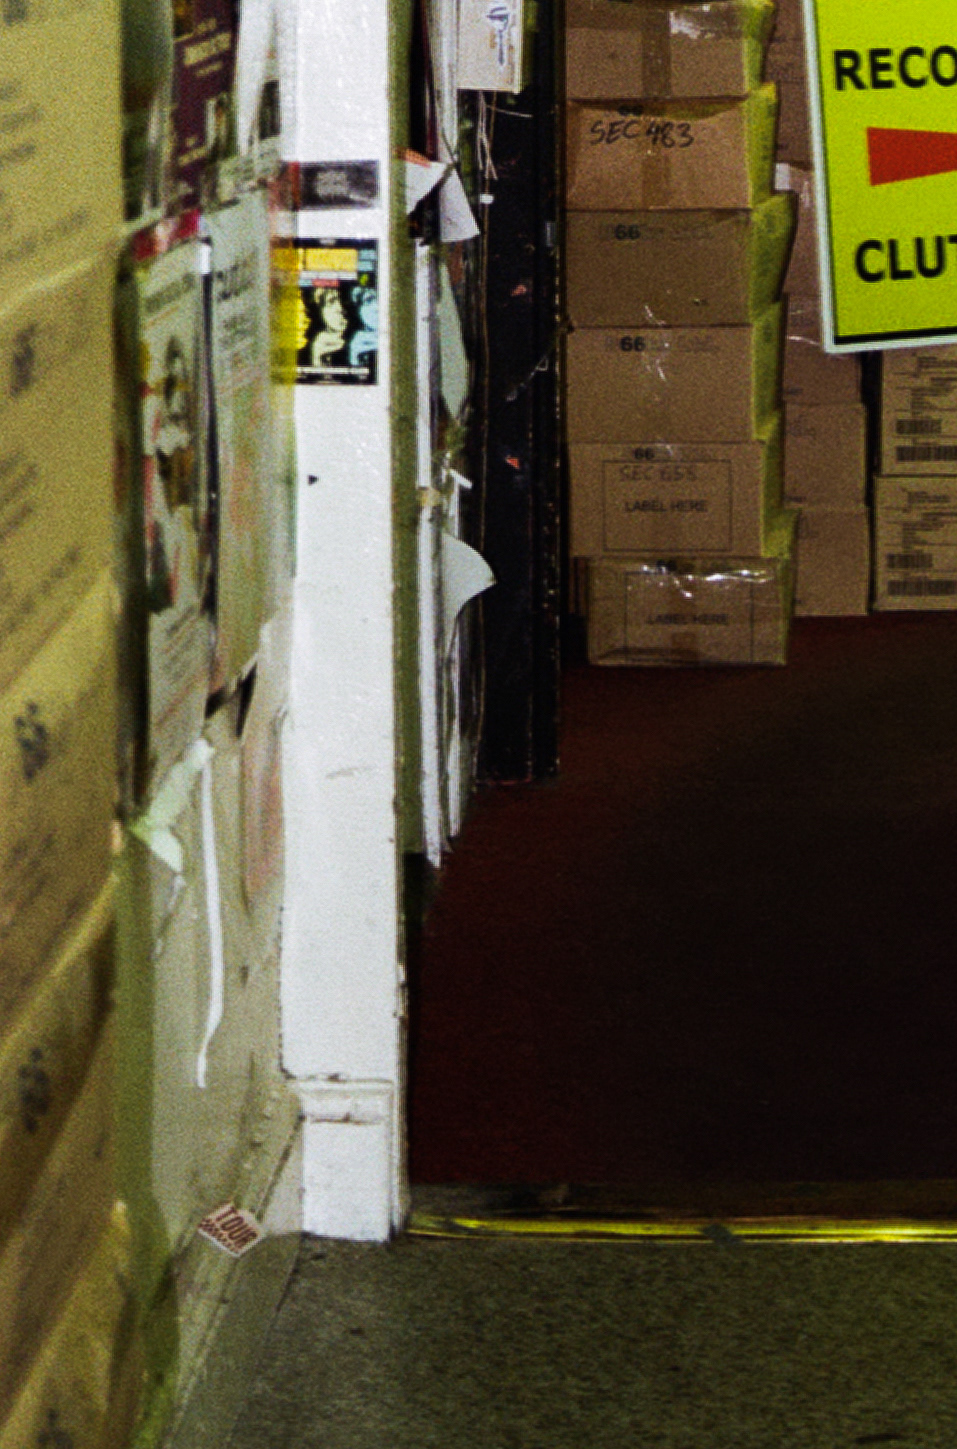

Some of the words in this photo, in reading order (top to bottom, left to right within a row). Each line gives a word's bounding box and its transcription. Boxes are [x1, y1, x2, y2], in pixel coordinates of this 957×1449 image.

[590, 118, 641, 146] SEC
[614, 224, 641, 240] 66
[620, 336, 646, 352] 66
